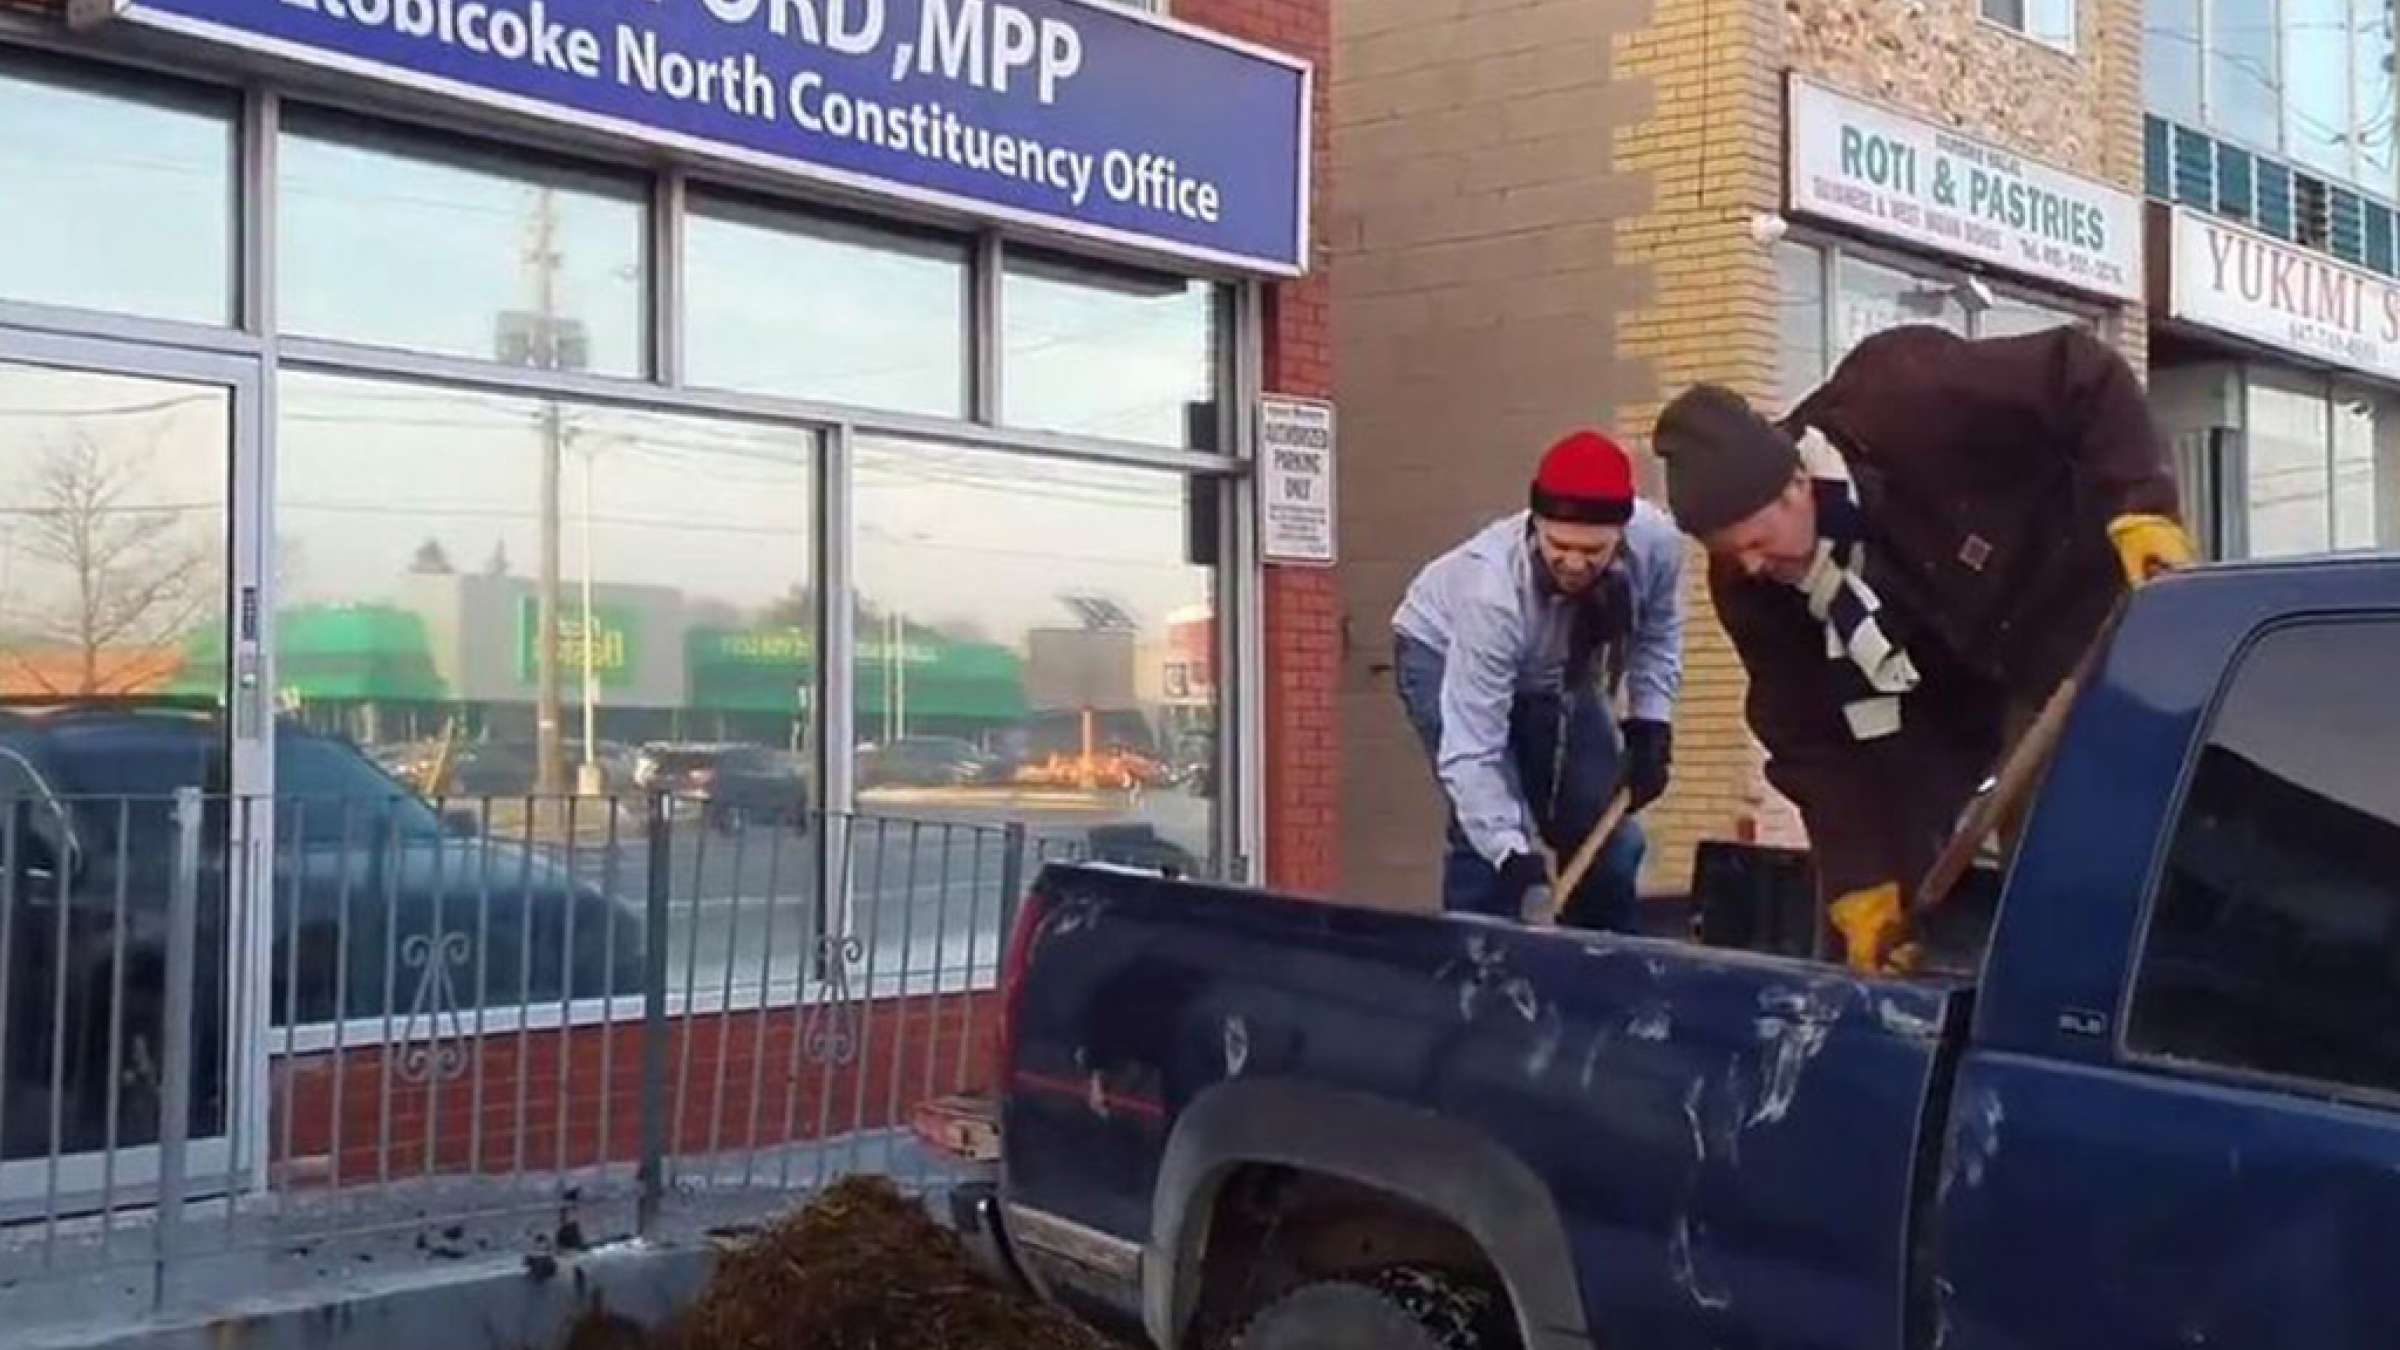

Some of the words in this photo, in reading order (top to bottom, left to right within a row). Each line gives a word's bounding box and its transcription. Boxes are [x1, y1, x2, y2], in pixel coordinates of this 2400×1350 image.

[280, 0, 600, 77] obicoke
[615, 24, 775, 121] North
[788, 70, 1094, 204] Constituency
[1102, 150, 1220, 223] Office
[1840, 125, 1917, 196] ROTI
[1933, 157, 1957, 207] &
[1970, 168, 2104, 251] PASTRIES
